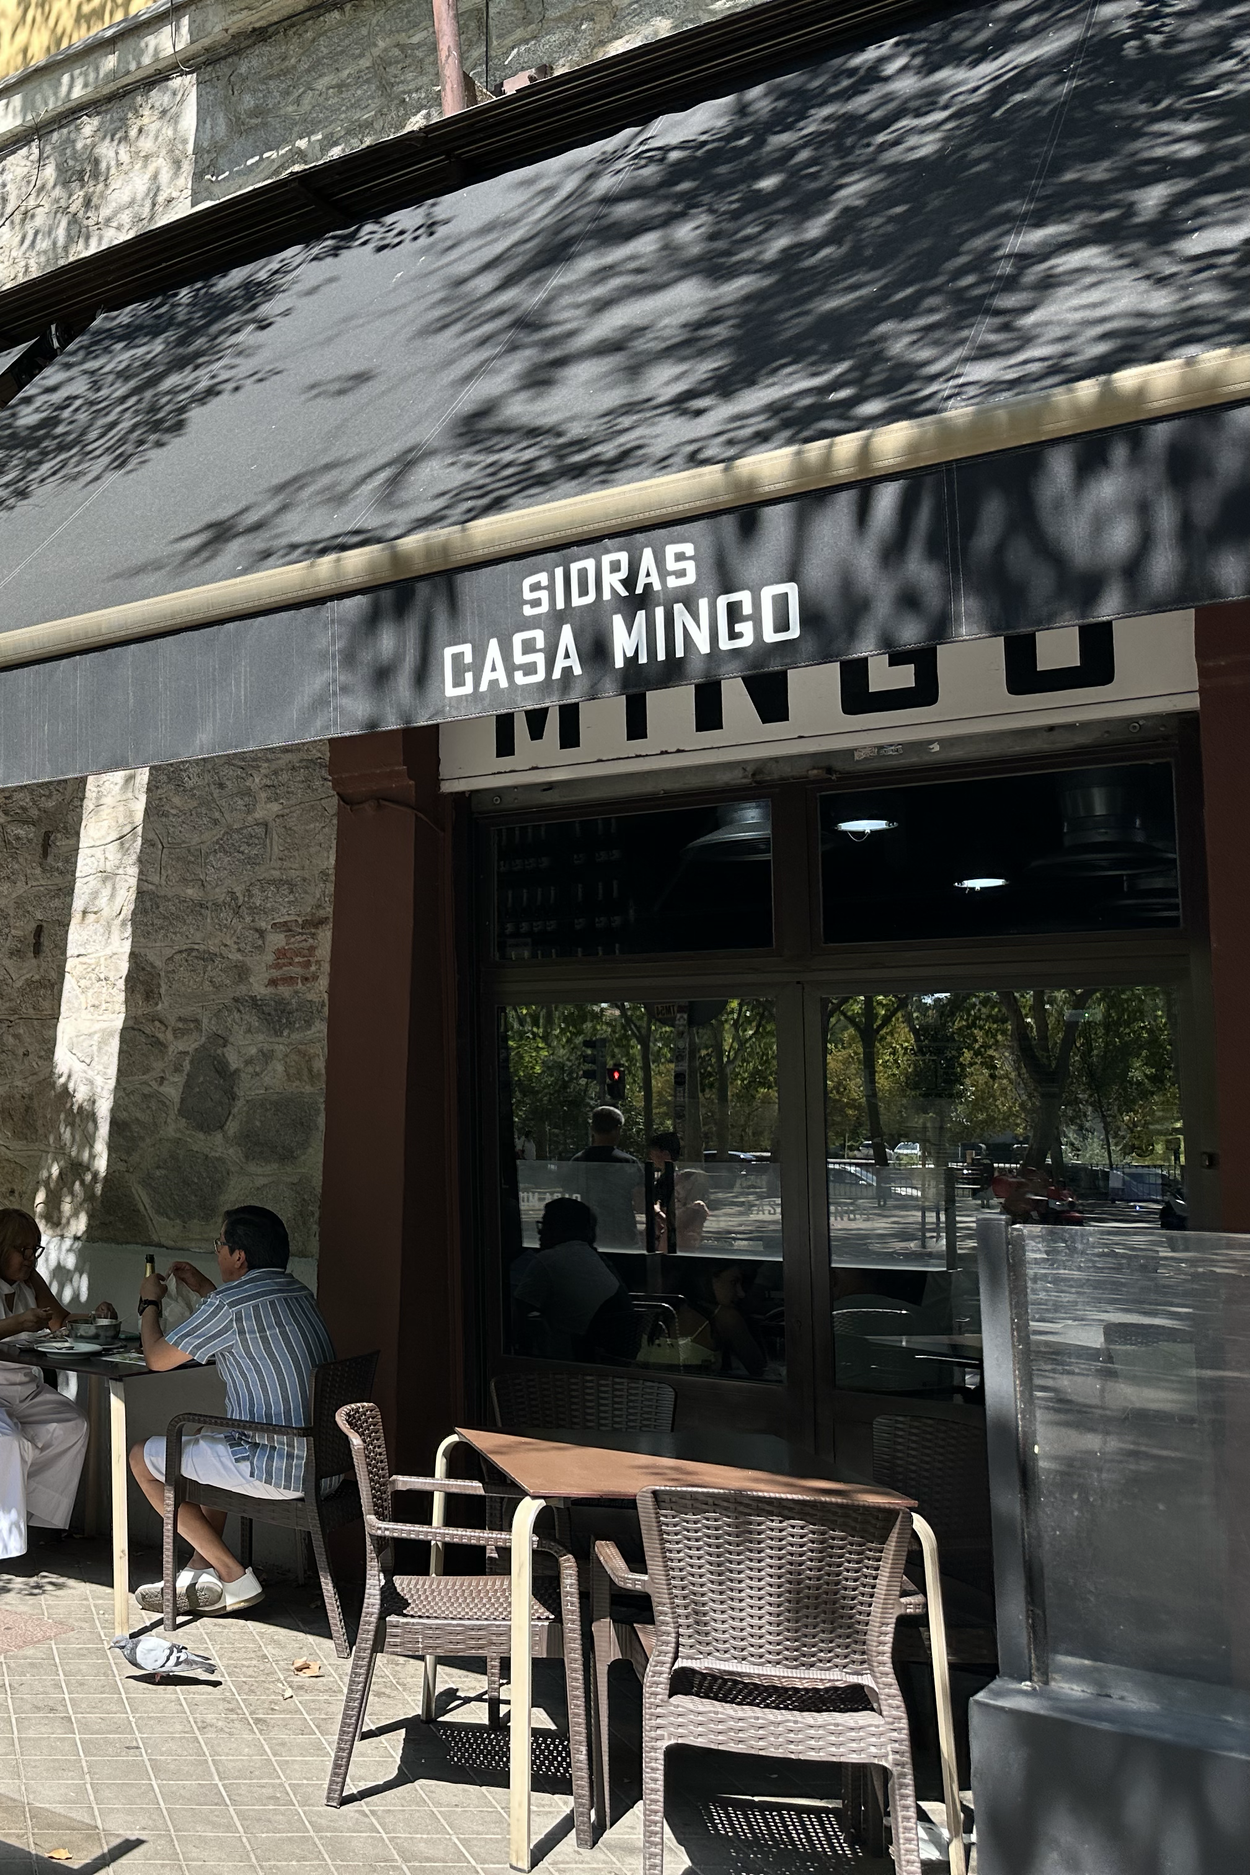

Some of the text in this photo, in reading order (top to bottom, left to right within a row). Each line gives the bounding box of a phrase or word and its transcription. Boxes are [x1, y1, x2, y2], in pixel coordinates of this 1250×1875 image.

[522, 542, 697, 617] SIDRAS
[443, 623, 583, 698] CASA
[612, 582, 801, 669] MINGO
